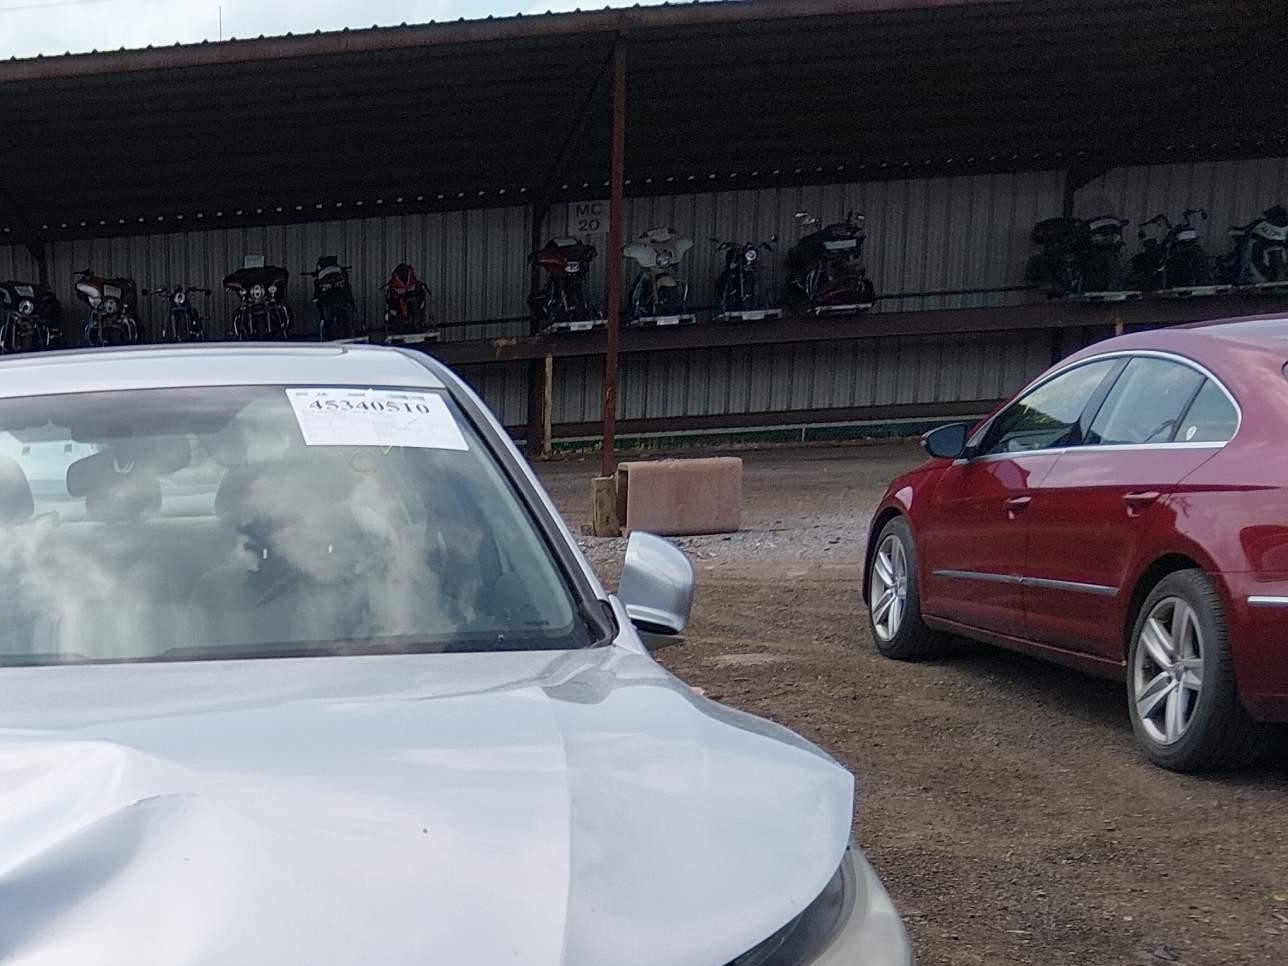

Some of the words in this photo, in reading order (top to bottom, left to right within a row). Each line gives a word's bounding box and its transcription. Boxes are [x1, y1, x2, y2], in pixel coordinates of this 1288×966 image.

[575, 203, 602, 216] MC
[578, 220, 600, 232] 20
[309, 399, 431, 415] 45340510
